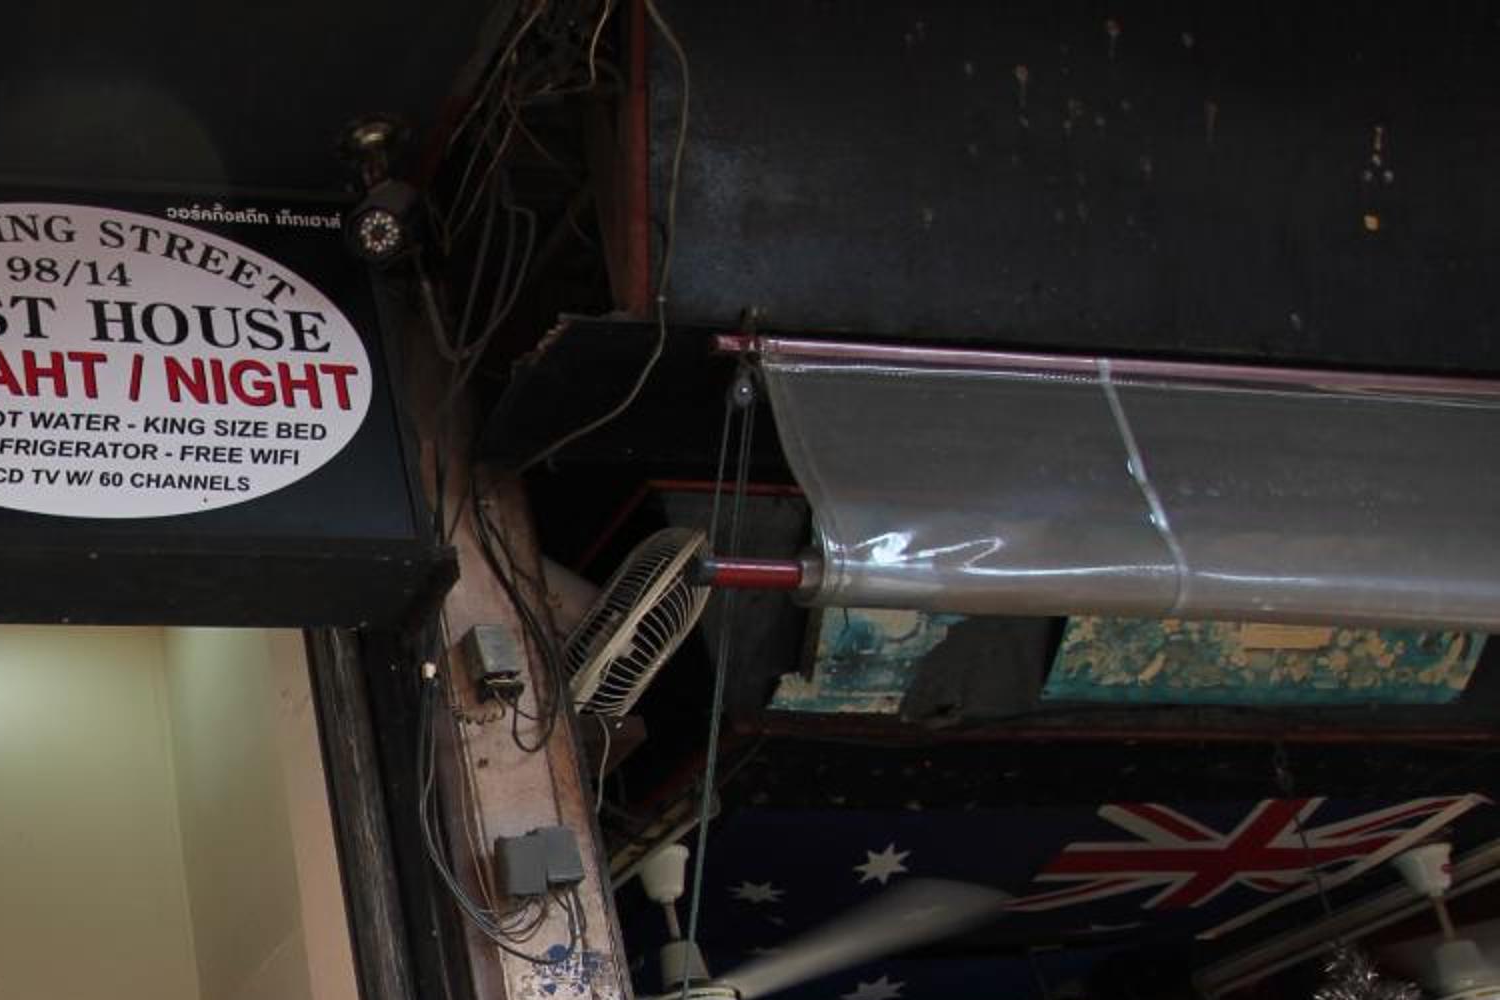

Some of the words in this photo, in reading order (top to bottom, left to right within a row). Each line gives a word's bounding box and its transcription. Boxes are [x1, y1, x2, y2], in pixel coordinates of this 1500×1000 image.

[5, 256, 133, 287] 98/14
[98, 220, 298, 305] STREET
[89, 298, 333, 354] HOUSE
[164, 356, 359, 411] NIGHT
[29, 411, 121, 433] WATER
[143, 415, 206, 437] KING
[213, 418, 269, 439] SIZE
[276, 420, 328, 441] BED
[179, 443, 244, 464] FREE
[249, 446, 300, 466] WIFI
[33, 468, 60, 486] TV
[64, 469, 93, 487] W/
[99, 470, 124, 488] 60
[128, 471, 251, 493] CHANNELS
